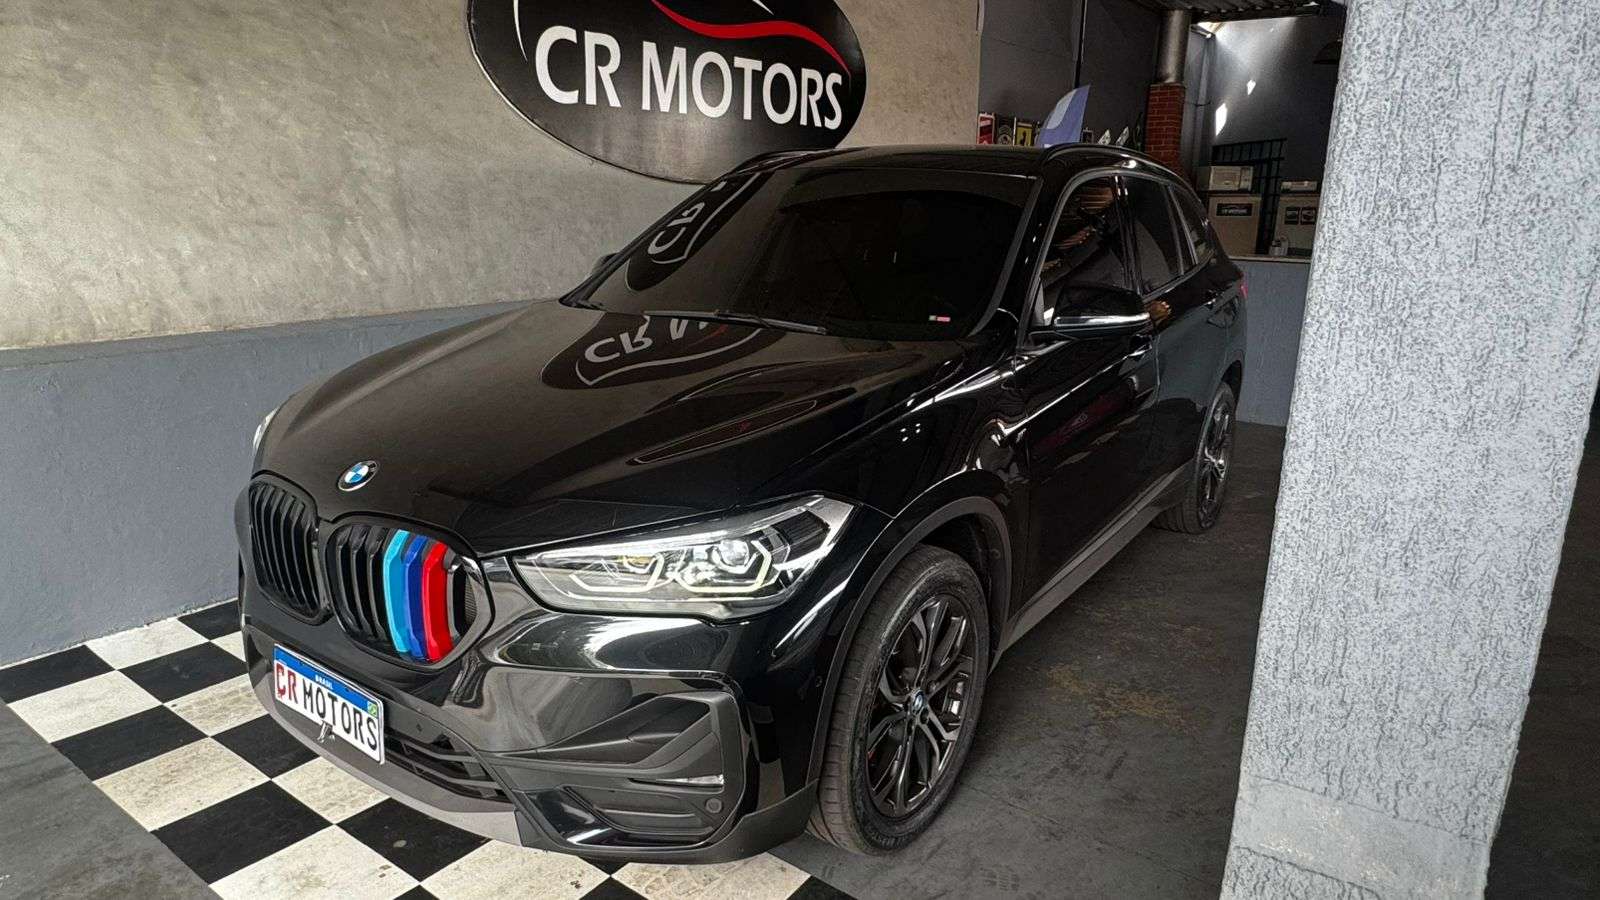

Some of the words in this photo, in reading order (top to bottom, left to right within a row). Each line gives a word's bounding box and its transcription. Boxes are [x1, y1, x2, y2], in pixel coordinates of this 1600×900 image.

[535, 25, 622, 107] CR
[641, 41, 842, 131] MOTORS
[276, 663, 298, 704] CR
[302, 678, 378, 751] MOTORS
